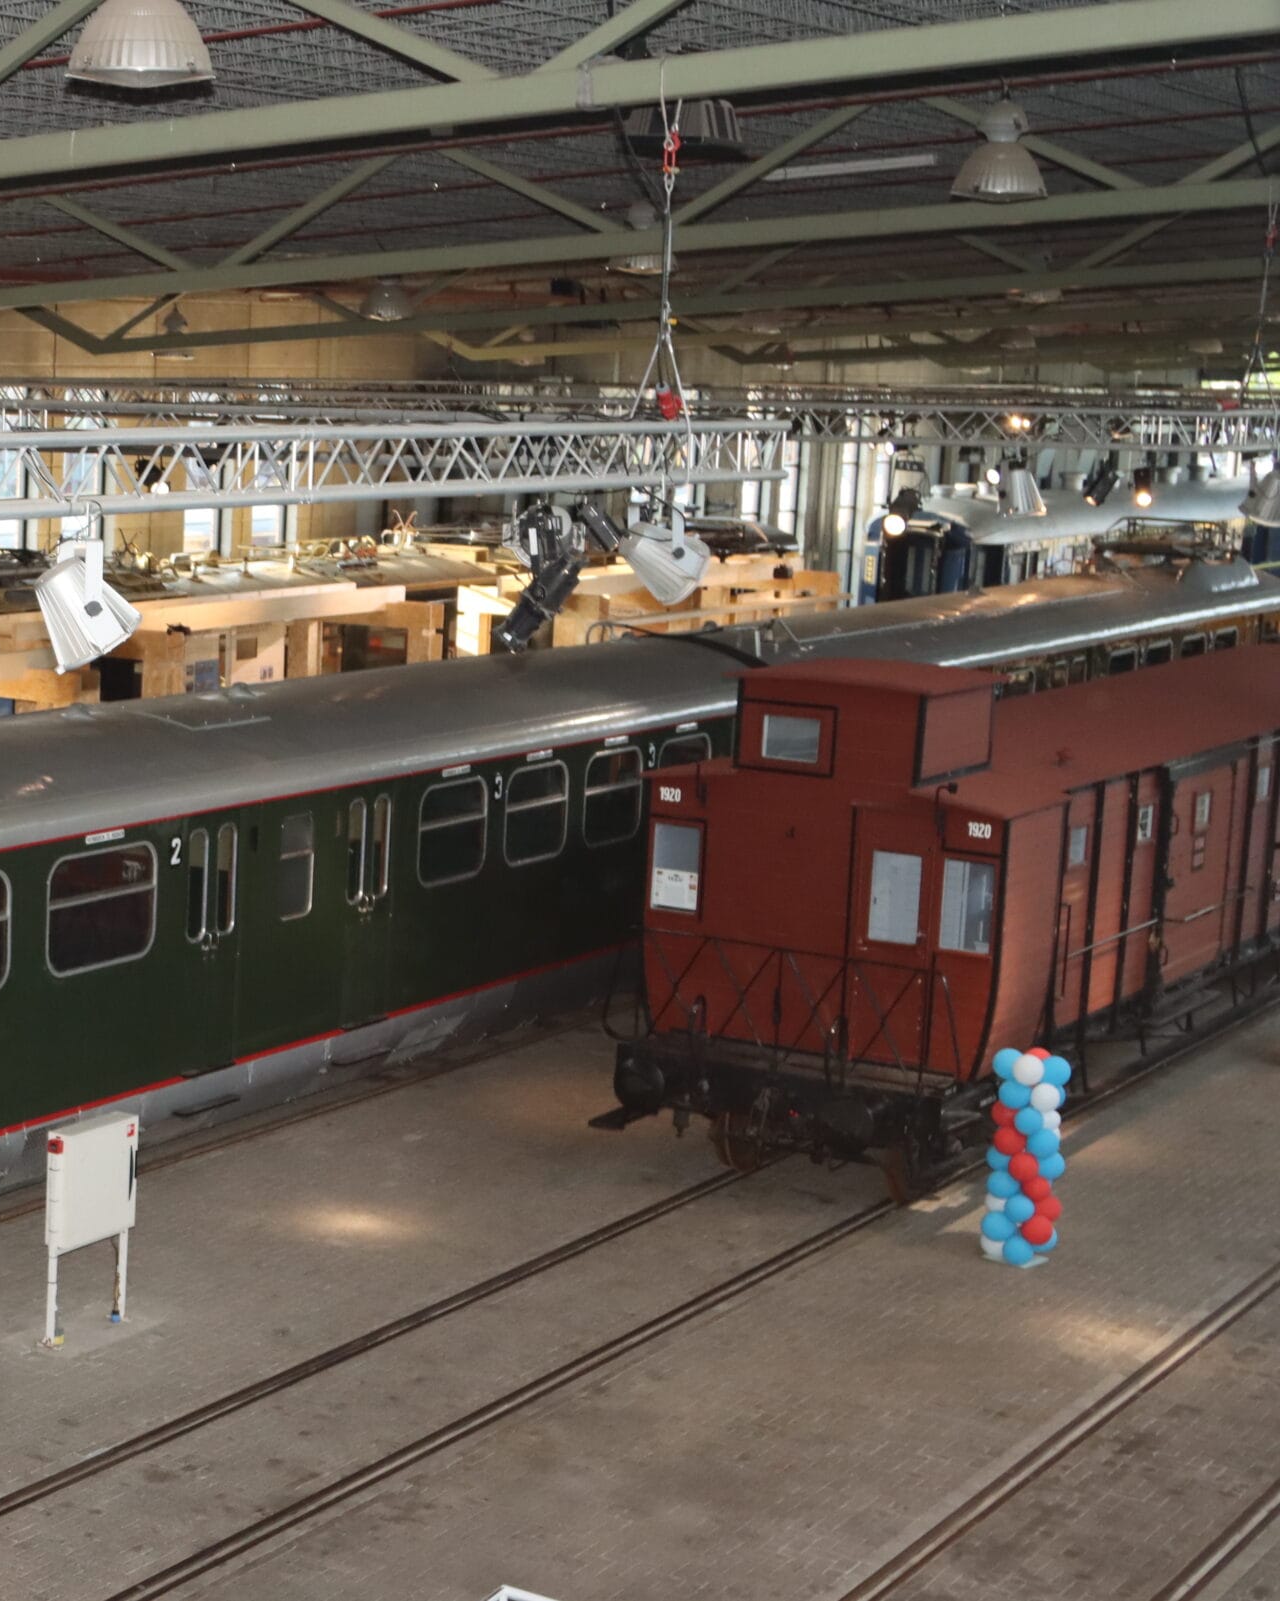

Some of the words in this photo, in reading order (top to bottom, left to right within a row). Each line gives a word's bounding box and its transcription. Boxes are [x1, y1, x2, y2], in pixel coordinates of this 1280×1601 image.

[648, 742, 656, 768] 3
[494, 773, 503, 800] 3
[659, 786, 682, 803] 1920
[968, 821, 992, 840] 1920
[170, 837, 182, 866] 2
